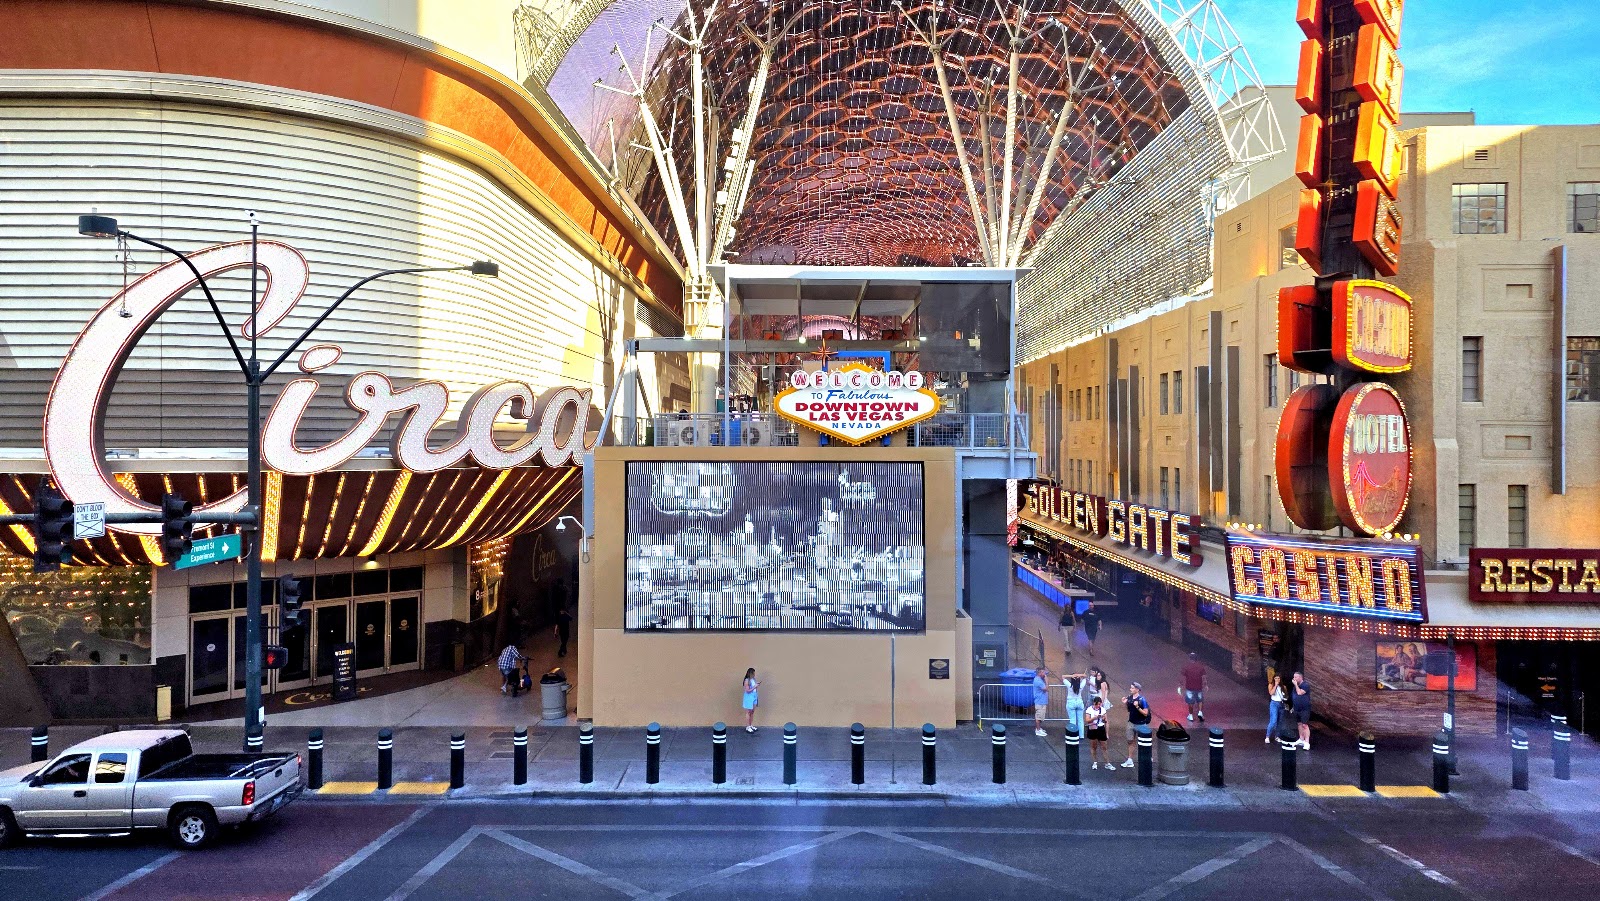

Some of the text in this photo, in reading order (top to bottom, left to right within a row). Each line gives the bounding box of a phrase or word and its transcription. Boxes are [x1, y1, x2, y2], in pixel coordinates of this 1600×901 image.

[1352, 293, 1410, 359] CASINO
[43, 240, 598, 534] Circa
[792, 374, 919, 387] WELCOME
[811, 389, 894, 402] TO Fabulous
[795, 402, 919, 412] DOWNTOWN
[808, 412, 906, 422] LAS VEGAS
[831, 422, 882, 430] NEVADA
[1352, 414, 1408, 455] HOTEL
[91, 512, 99, 520] BOX
[1027, 484, 1102, 535] GOLDEN
[1108, 500, 1194, 565] GATE
[190, 552, 215, 563] Experience
[1230, 544, 1414, 614] CASINO
[1480, 558, 1600, 593] RESTA
